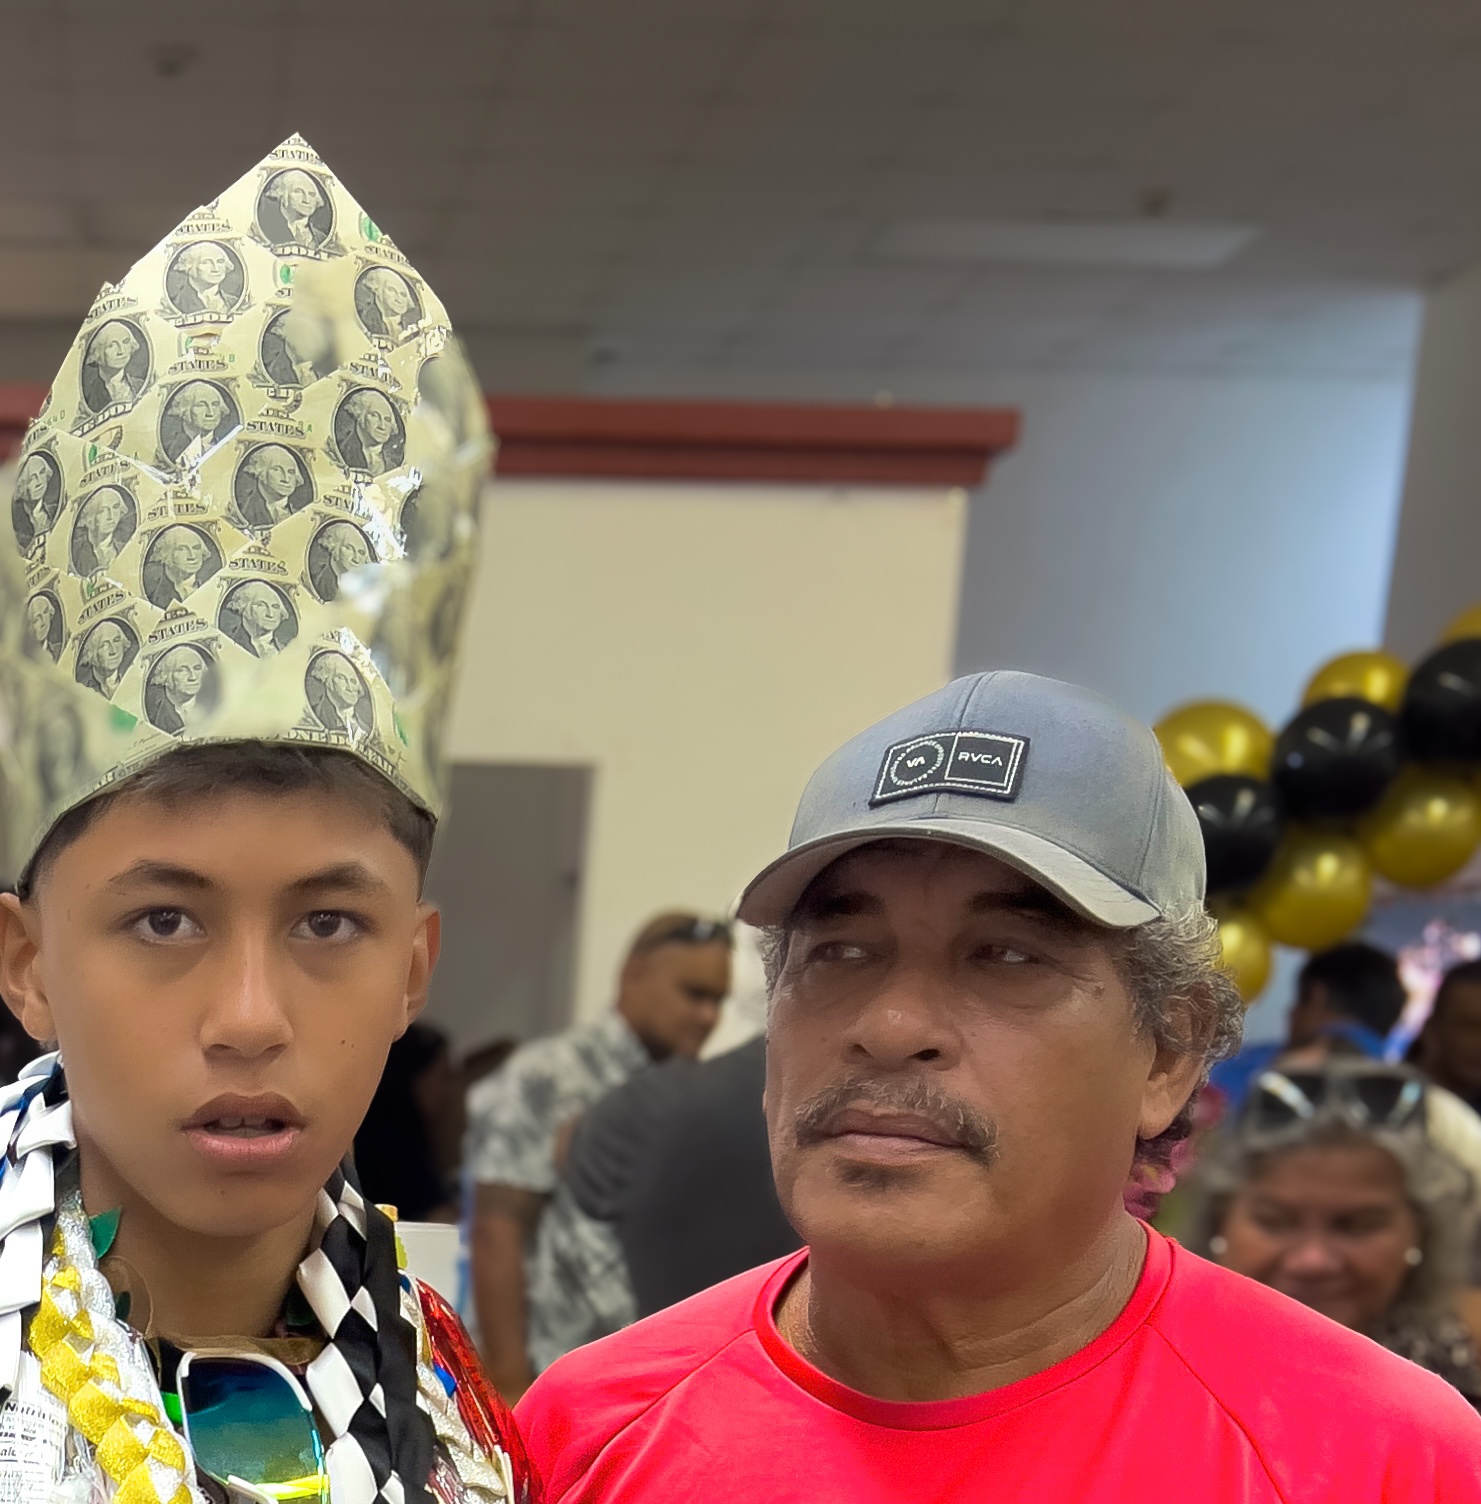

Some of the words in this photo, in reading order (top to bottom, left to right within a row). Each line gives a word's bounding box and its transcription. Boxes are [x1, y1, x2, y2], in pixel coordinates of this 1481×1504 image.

[246, 420, 306, 438] STATES
[229, 557, 288, 577] STATES
[148, 617, 208, 644] STATES
[958, 751, 1004, 767] RVCA
